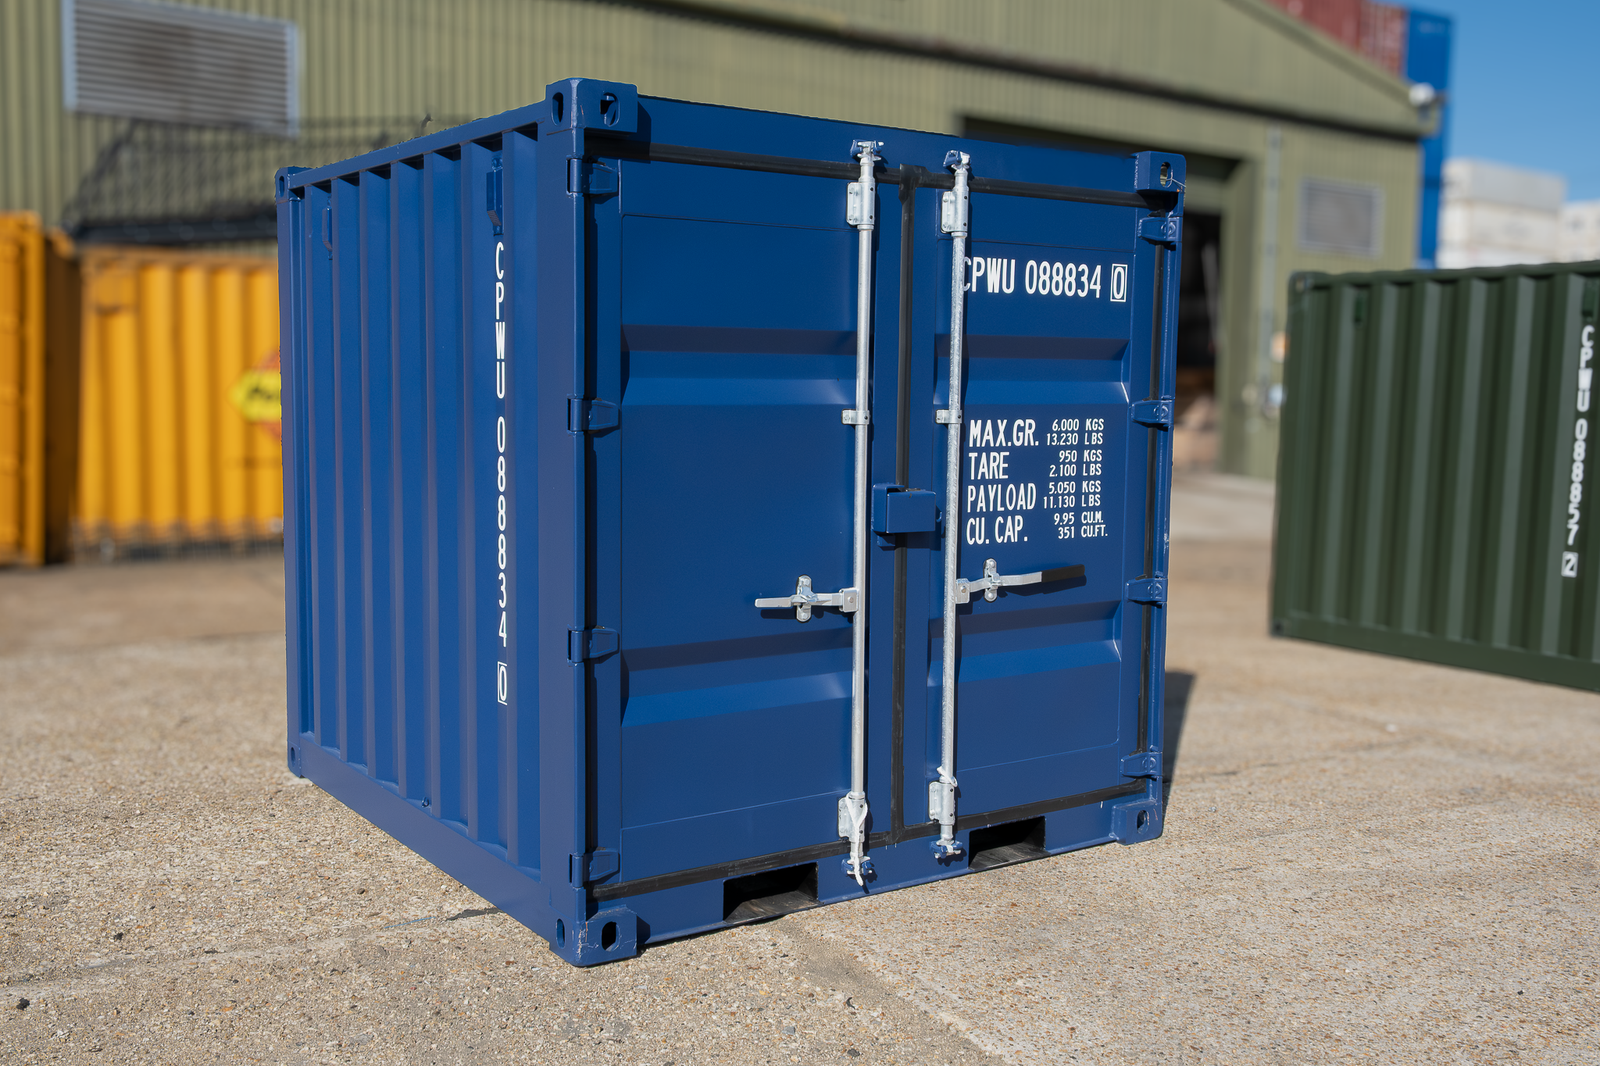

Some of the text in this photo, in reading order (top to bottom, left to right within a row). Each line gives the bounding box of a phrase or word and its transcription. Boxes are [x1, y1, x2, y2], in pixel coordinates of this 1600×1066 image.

[1024, 260, 1102, 298] 088834
[1111, 265, 1127, 301] 0
[495, 242, 506, 398] CPWU
[968, 419, 1039, 447] MAX.GR.
[1085, 419, 1105, 430] KGS
[1084, 433, 1104, 444] LBS
[1058, 450, 1103, 462] 950 KGS
[1562, 326, 1594, 577] CPWU 088857 2
[968, 452, 1010, 480] TARE
[1082, 464, 1102, 476] LBS
[1081, 480, 1102, 492] KGS
[967, 483, 1037, 512] PAYLOAD
[1081, 494, 1101, 506] LBS
[1053, 512, 1075, 525] 9.95
[496, 416, 508, 647] 088834
[966, 515, 1028, 545] CU. CAP.
[1057, 527, 1075, 539] 351
